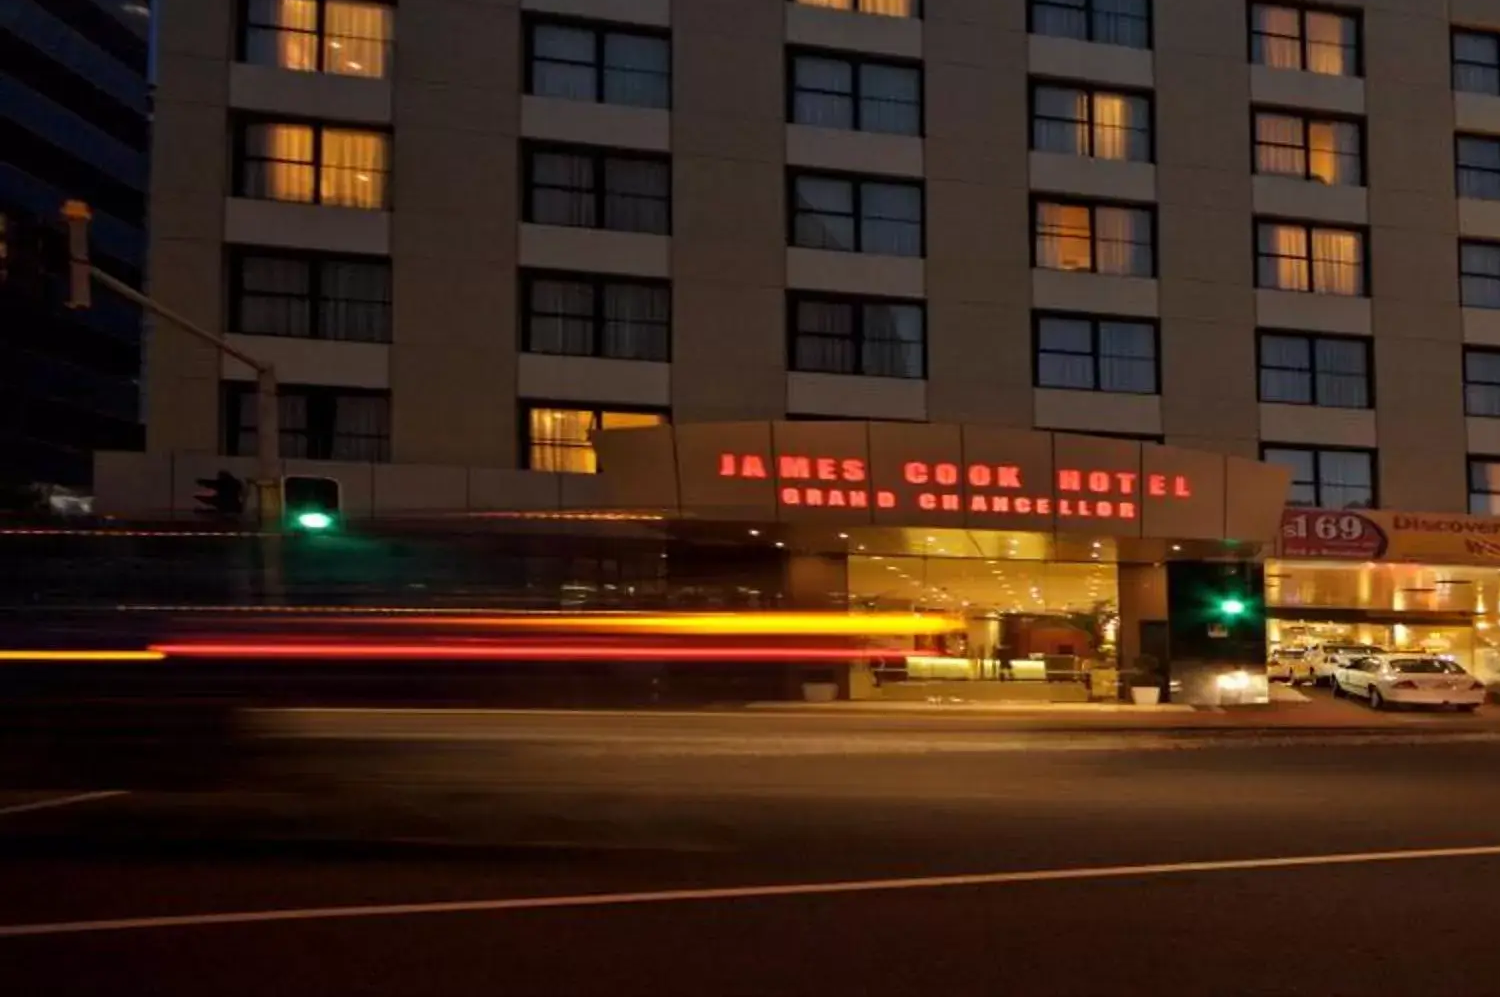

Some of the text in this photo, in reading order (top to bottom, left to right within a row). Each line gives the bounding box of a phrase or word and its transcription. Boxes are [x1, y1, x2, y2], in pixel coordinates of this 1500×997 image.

[719, 453, 1192, 497] JAMES COOK HOTEL
[781, 487, 1136, 519] GRAND CHANCELLOR
